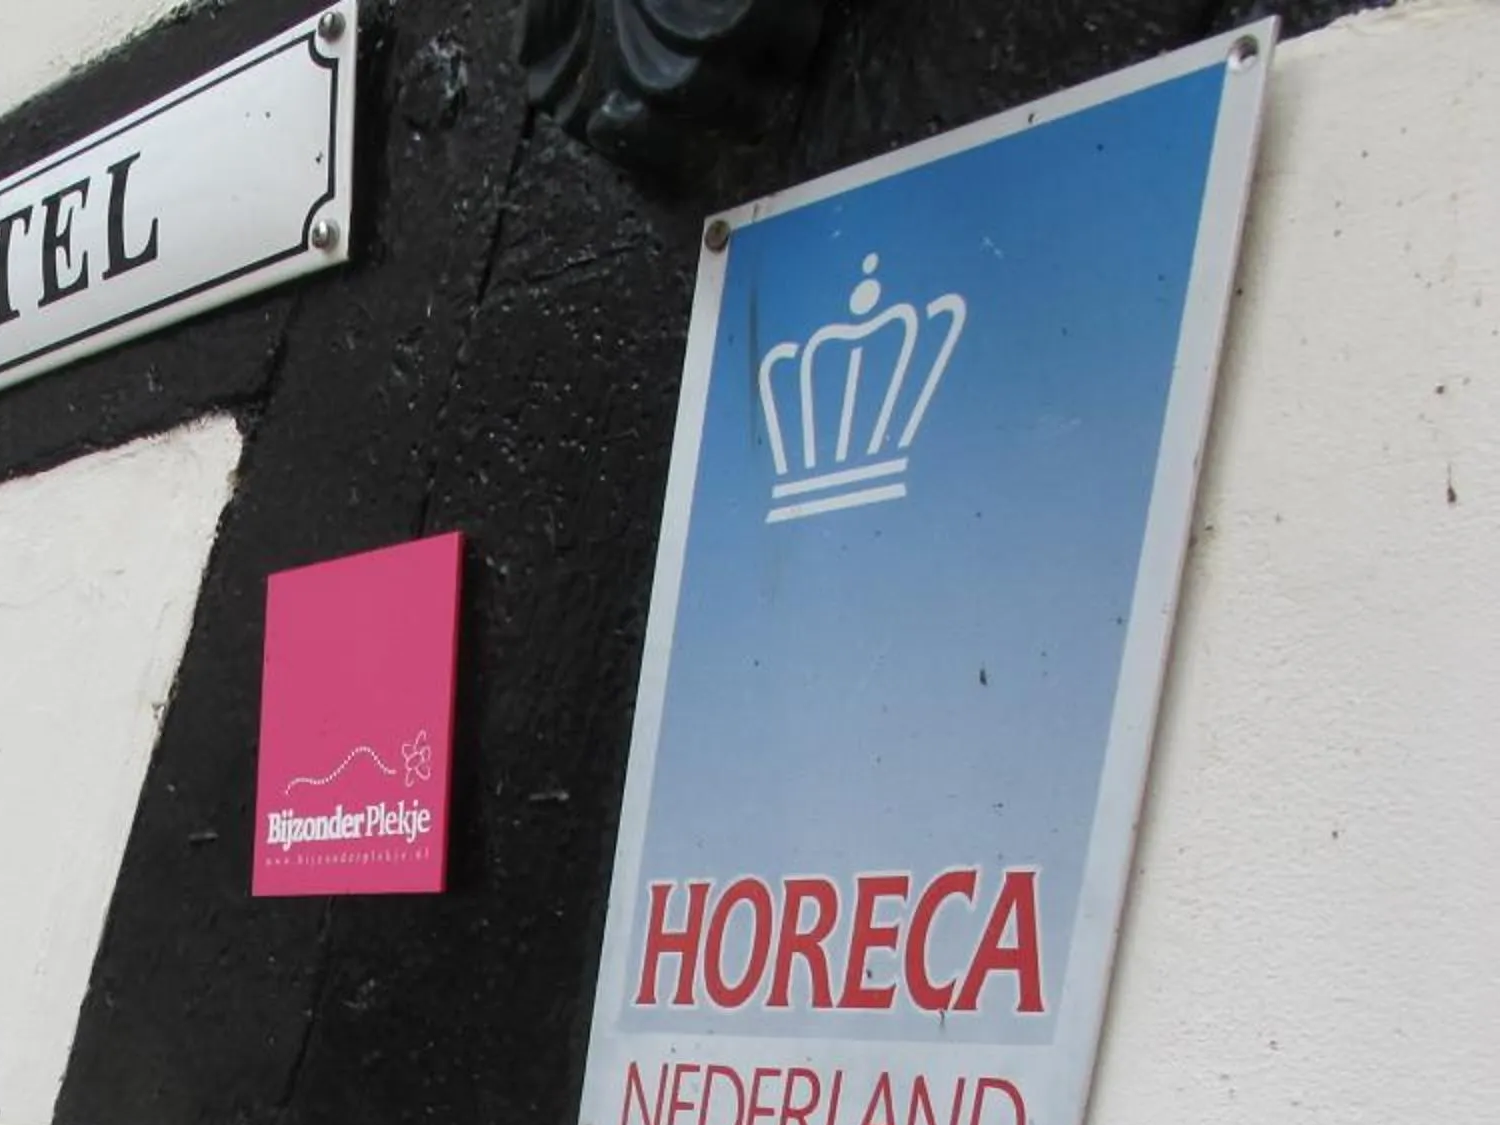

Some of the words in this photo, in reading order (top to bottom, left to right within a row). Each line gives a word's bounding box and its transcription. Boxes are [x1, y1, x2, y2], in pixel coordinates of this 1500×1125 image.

[266, 808, 364, 852] Bijzonder
[364, 799, 432, 844] Plekje
[634, 868, 1046, 1014] HORECA
